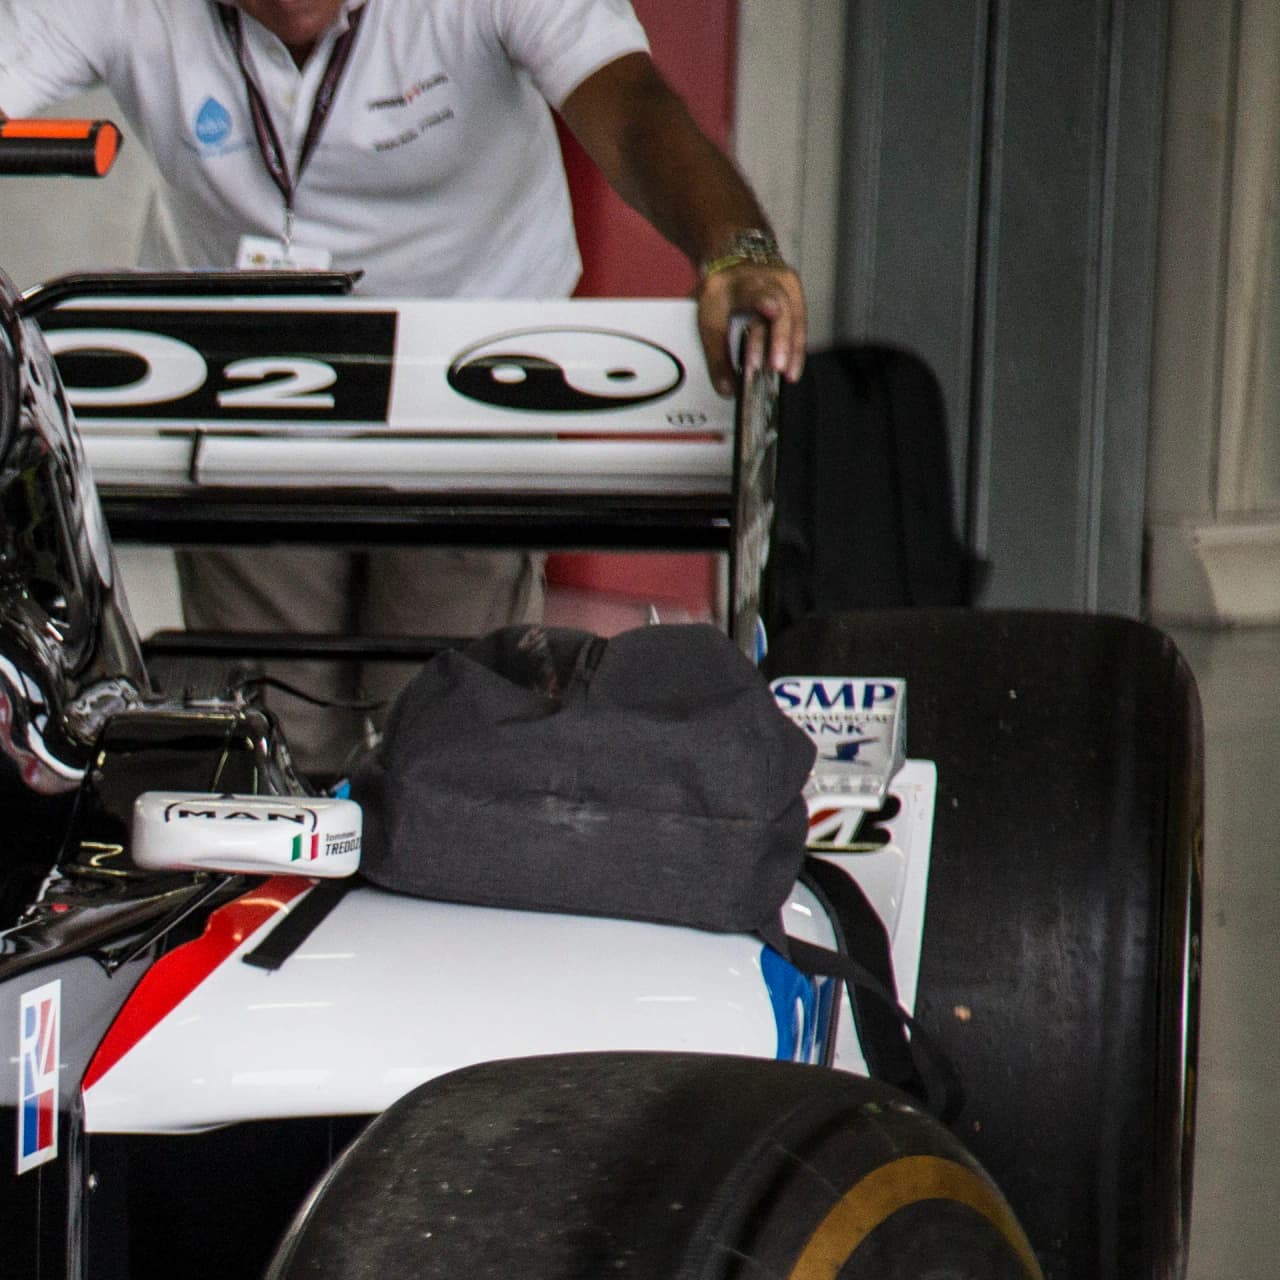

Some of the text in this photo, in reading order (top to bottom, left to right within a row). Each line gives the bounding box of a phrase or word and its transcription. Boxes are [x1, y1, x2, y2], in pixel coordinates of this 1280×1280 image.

[774, 680, 897, 710] SMP
[804, 722, 864, 735] ANK
[178, 809, 306, 825] MAN
